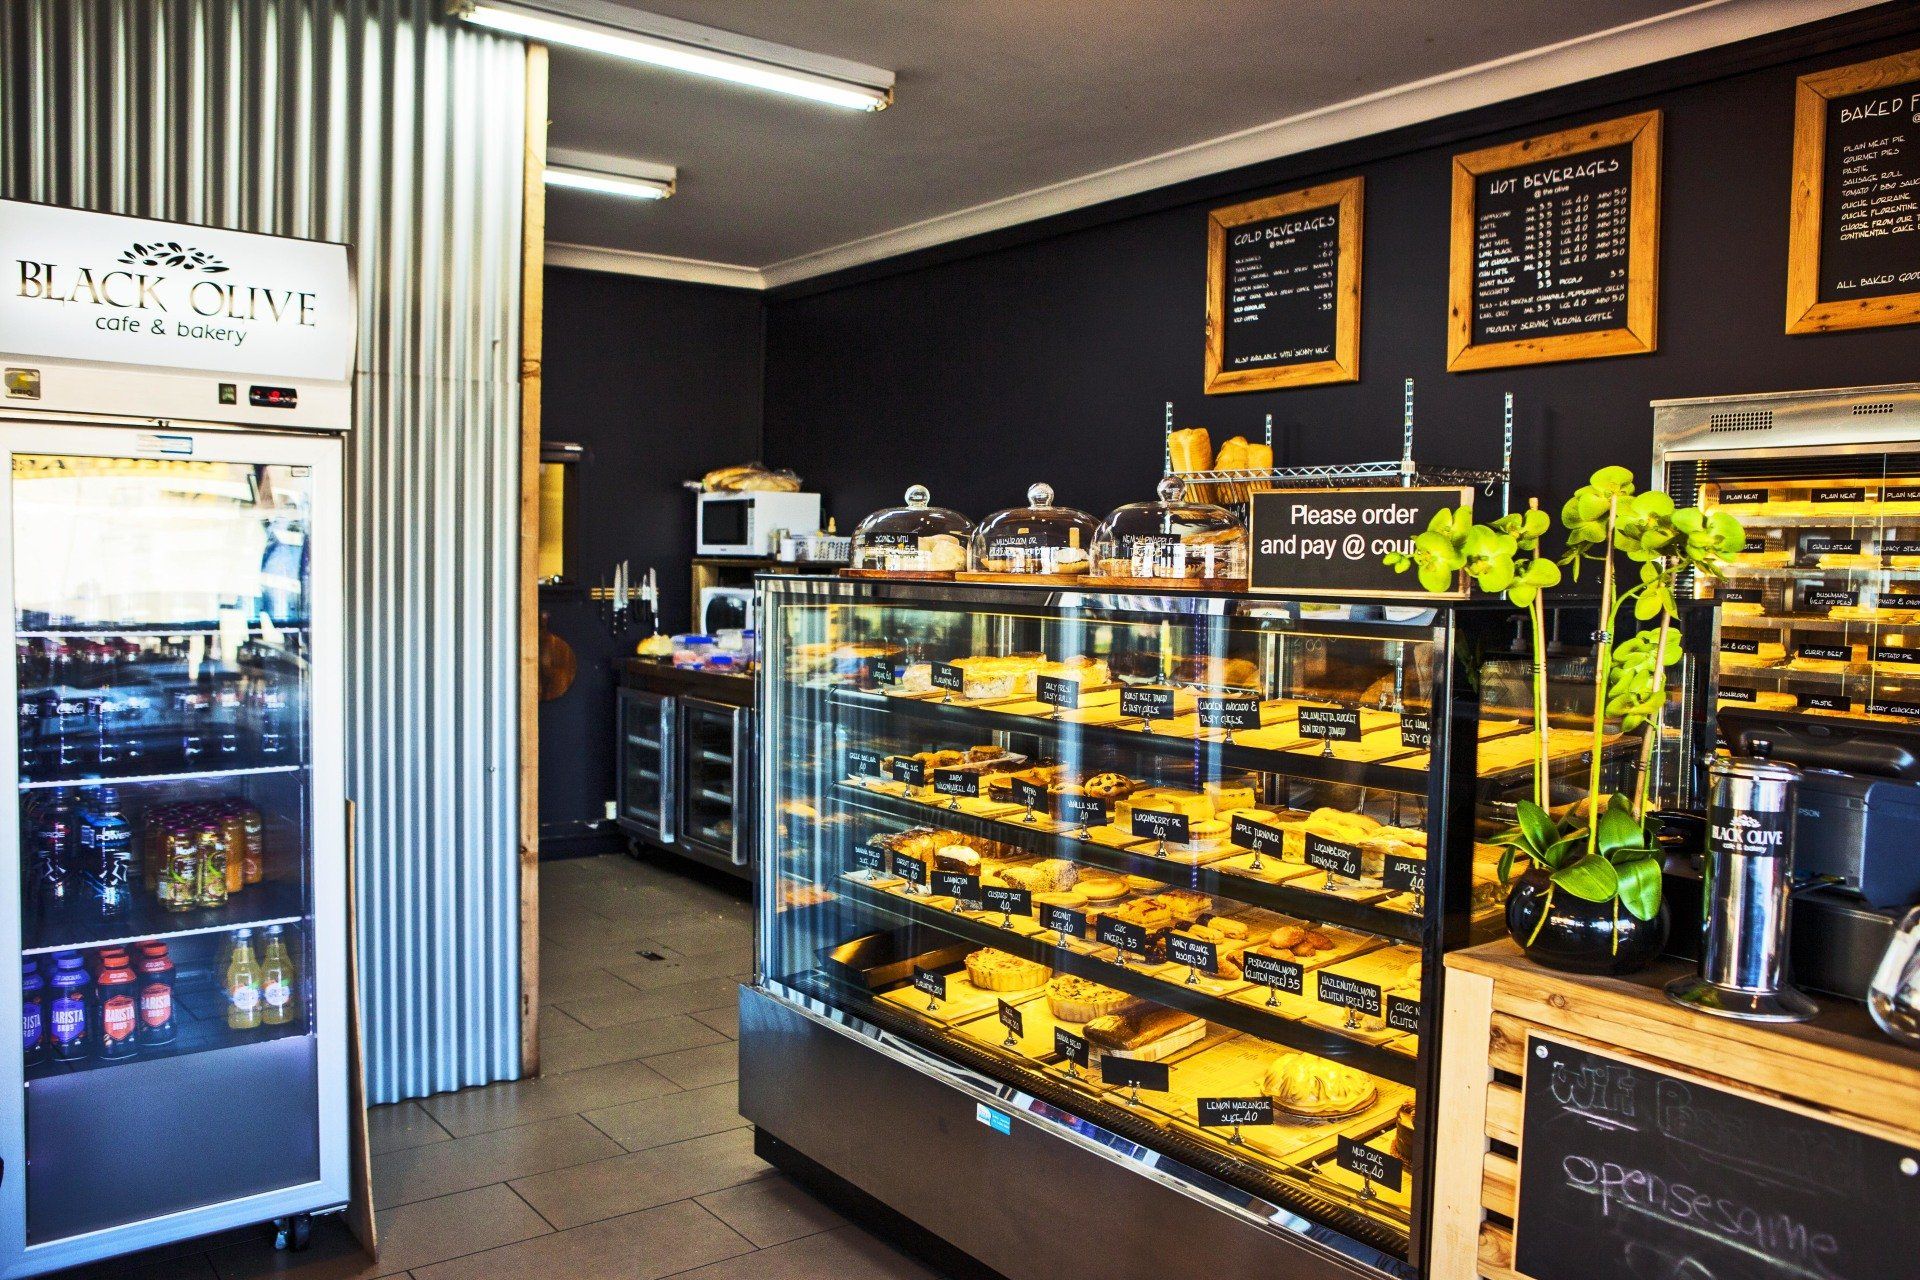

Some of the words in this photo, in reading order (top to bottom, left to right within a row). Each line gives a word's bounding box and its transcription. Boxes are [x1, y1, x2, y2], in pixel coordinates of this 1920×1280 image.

[1841, 98, 1902, 123] BAKED
[1844, 142, 1865, 152] PLAIN
[1868, 138, 1889, 148] MEAT
[1844, 152, 1878, 164] GOURMET
[1843, 165, 1868, 174] PASTIE
[1490, 179, 1517, 195] HOT
[1524, 159, 1619, 189] BEVERAGES
[1843, 174, 1878, 186] SAUSAGE
[1881, 171, 1903, 179] ROLL
[1554, 186, 1570, 194] olive
[1842, 187, 1869, 196] TOMATO
[1871, 193, 1910, 205] LORRAINE
[1871, 203, 1918, 217] FLORENTINE
[1235, 230, 1262, 246] COLD
[1266, 216, 1335, 239] BEVERAGES
[1841, 222, 1869, 232] CHOOSE
[1872, 218, 1893, 228] FROM
[1840, 229, 1889, 240] CONTINENTAL
[1892, 224, 1914, 233] CAKE
[1837, 281, 1856, 289] ALL
[1861, 275, 1894, 286] BAKED
[16, 260, 168, 312] BLACK
[190, 281, 317, 328] OLIVE
[96, 315, 140, 333] cafe
[151, 319, 165, 335] &
[178, 321, 247, 346] bakery
[1486, 325, 1517, 334] PROUDLY
[1291, 504, 1356, 525] Please
[1362, 503, 1418, 524] order
[1261, 534, 1296, 555] and
[1301, 539, 1337, 560] pay
[1342, 534, 1365, 560] @
[952, 677, 959, 687] 60
[1123, 701, 1127, 712] &
[1225, 702, 1249, 711] AVOCADO
[1251, 701, 1257, 712] &
[1200, 714, 1219, 724] TASTY
[1402, 719, 1413, 729] LEG
[1301, 724, 1311, 733] SUN
[1402, 733, 1420, 744] TASTY
[967, 783, 976, 793] 40
[1080, 810, 1088, 820] 40
[1172, 818, 1181, 827] PIE
[1153, 824, 1164, 836] 40
[1236, 823, 1252, 835] APPLE
[1254, 828, 1280, 843] TURNOVER
[1253, 838, 1262, 849] 40
[1747, 830, 1782, 845] OLIVE
[1310, 854, 1338, 870] TURNOVER
[1344, 861, 1355, 874] 40
[1395, 863, 1418, 874] APPLE
[944, 876, 968, 885] LAMINGTON
[1410, 876, 1424, 889] 40
[952, 884, 961, 894] 40
[988, 891, 1009, 900] CUSTARD
[1010, 893, 1021, 902] TART
[1000, 900, 1010, 910] 40
[1053, 910, 1071, 922] COCONUT
[1064, 922, 1073, 932] 40
[1115, 924, 1126, 933] CHOC
[1127, 938, 1137, 948] 35
[1172, 938, 1187, 950] HONEY
[1189, 943, 1209, 955] ORANGE
[1197, 954, 1207, 966] 30
[1245, 965, 1267, 981] (GLUTEN
[1269, 974, 1287, 986] FREE)
[1288, 980, 1300, 990] 35
[1322, 975, 1377, 998] HAZLENUT/ALMOND
[1320, 984, 1344, 1003] (GLUTEN
[1345, 996, 1364, 1009] FREE)
[1366, 999, 1379, 1011] 35
[106, 1006, 134, 1021] BARISTA
[1395, 1003, 1413, 1014] CHOC
[1390, 1010, 1418, 1029] (GLUTEN
[1206, 1102, 1230, 1110] LEMON
[1221, 1114, 1240, 1123] SLICE
[1244, 1111, 1258, 1122] 40
[1352, 1146, 1365, 1158] MUD
[1366, 1152, 1384, 1167] CAKE
[1352, 1160, 1370, 1174] SLICE
[1372, 1165, 1384, 1179] 40
